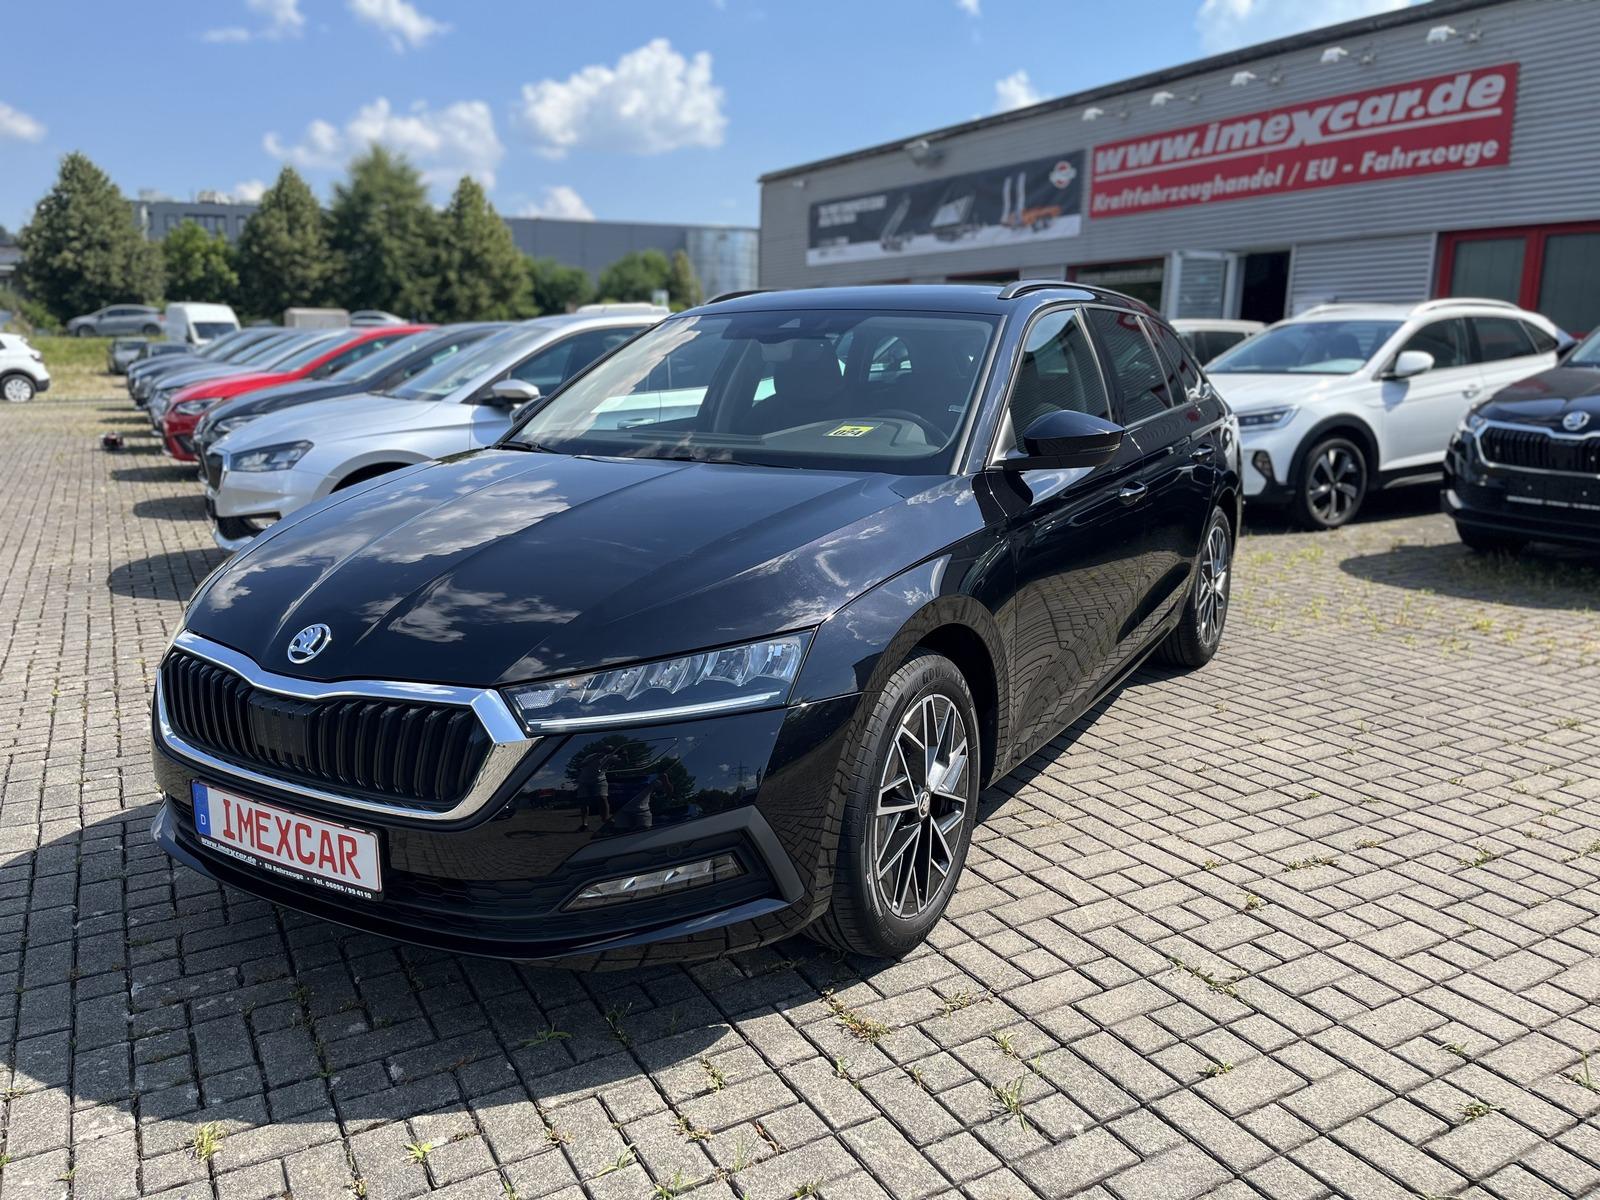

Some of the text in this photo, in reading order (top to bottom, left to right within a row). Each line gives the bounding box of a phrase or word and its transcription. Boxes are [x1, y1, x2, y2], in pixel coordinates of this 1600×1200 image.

[1095, 73, 1506, 174] www.imexcar.de
[1092, 163, 1285, 213] Kraftfahrzeughandel
[1287, 162, 1301, 186] /
[1305, 157, 1338, 182] EU
[1359, 139, 1499, 175] Fahrzeuge
[200, 813, 207, 826] D
[223, 798, 361, 880] IMEXCAR
[312, 877, 325, 886] Tel.
